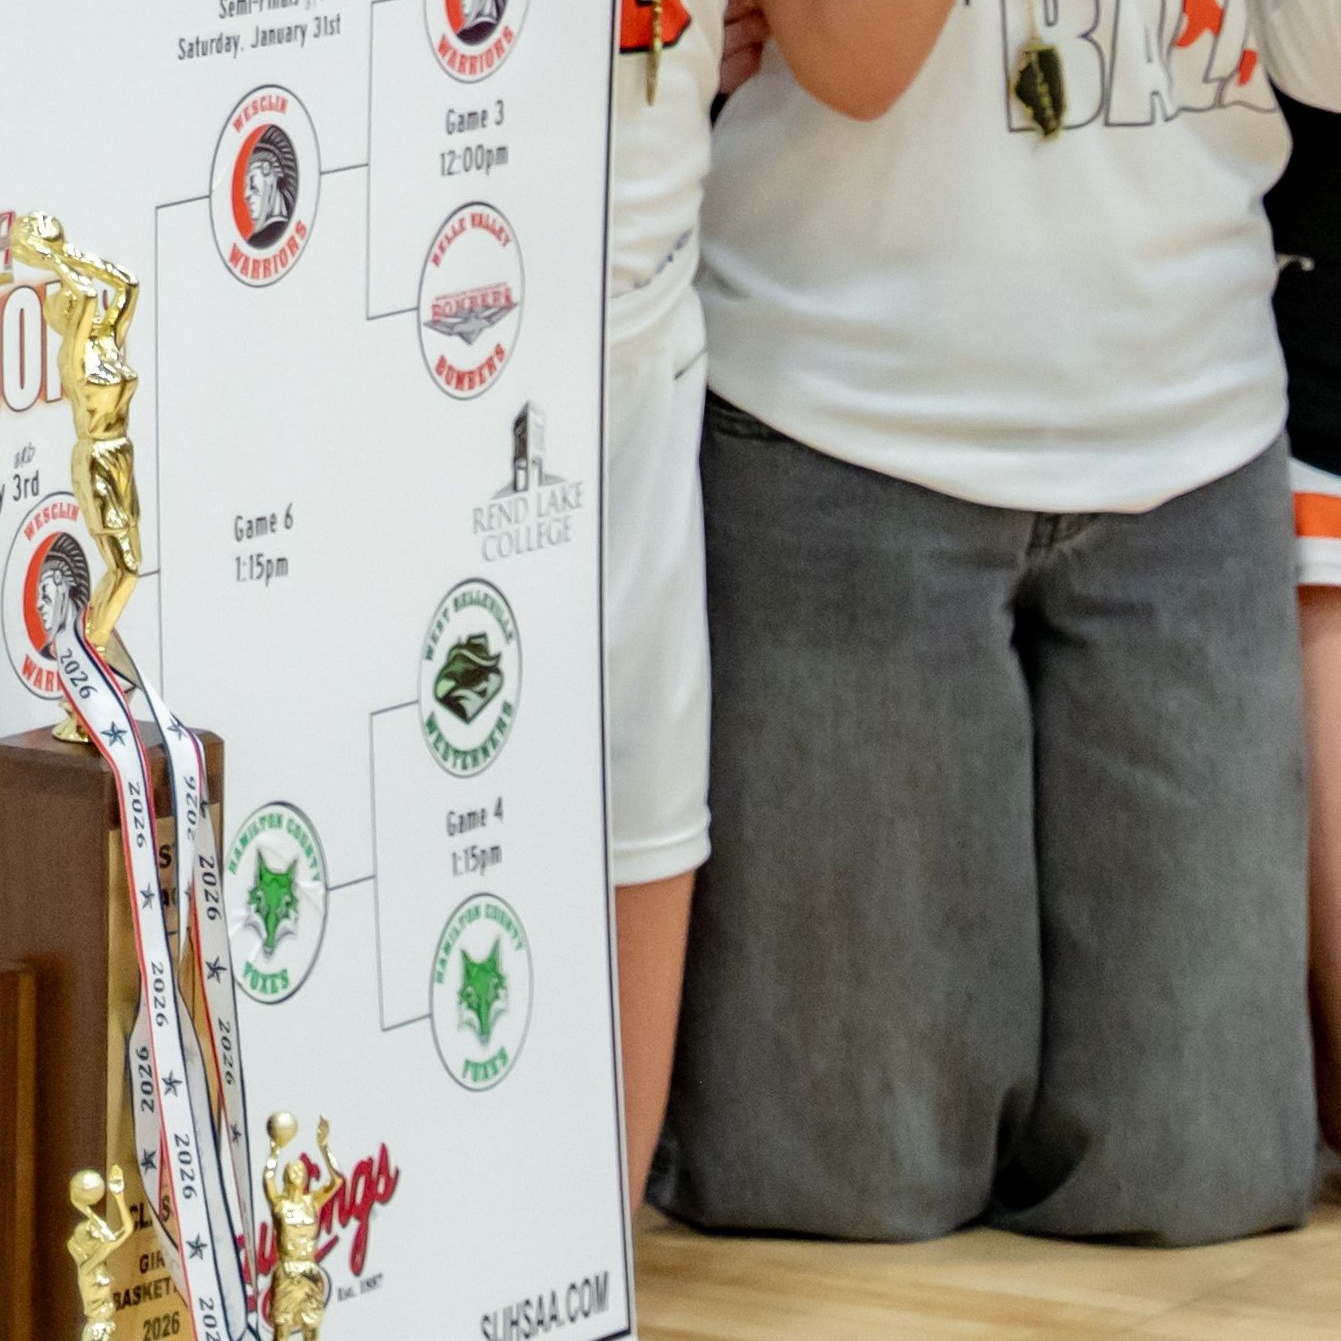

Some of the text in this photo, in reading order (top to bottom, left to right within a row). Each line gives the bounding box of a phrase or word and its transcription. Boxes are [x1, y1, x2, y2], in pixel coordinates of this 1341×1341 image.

[178, 13, 342, 61] Saturday, January 31st
[437, 24, 516, 77] WARRIORS
[232, 94, 289, 134] WESCLIN
[444, 100, 505, 137] Game 3
[439, 143, 509, 179] 12:00pm
[228, 218, 309, 281] WARRIORS
[12, 470, 41, 501] 3rd
[472, 480, 585, 535] REND LAKE
[23, 502, 80, 542] WESCLIN
[233, 503, 294, 542] Game 6
[482, 516, 573, 562] COLLEGE
[234, 552, 289, 584] 1:15pm
[60, 648, 99, 700] 2026
[128, 781, 148, 848] 2026
[446, 796, 504, 836] Game 4
[451, 844, 503, 877] 1:15pm
[199, 854, 222, 921] 2026
[149, 960, 169, 1028] 2026
[217, 1017, 236, 1086] 2026
[135, 1046, 156, 1113] 2026
[173, 1132, 198, 1200] 2026
